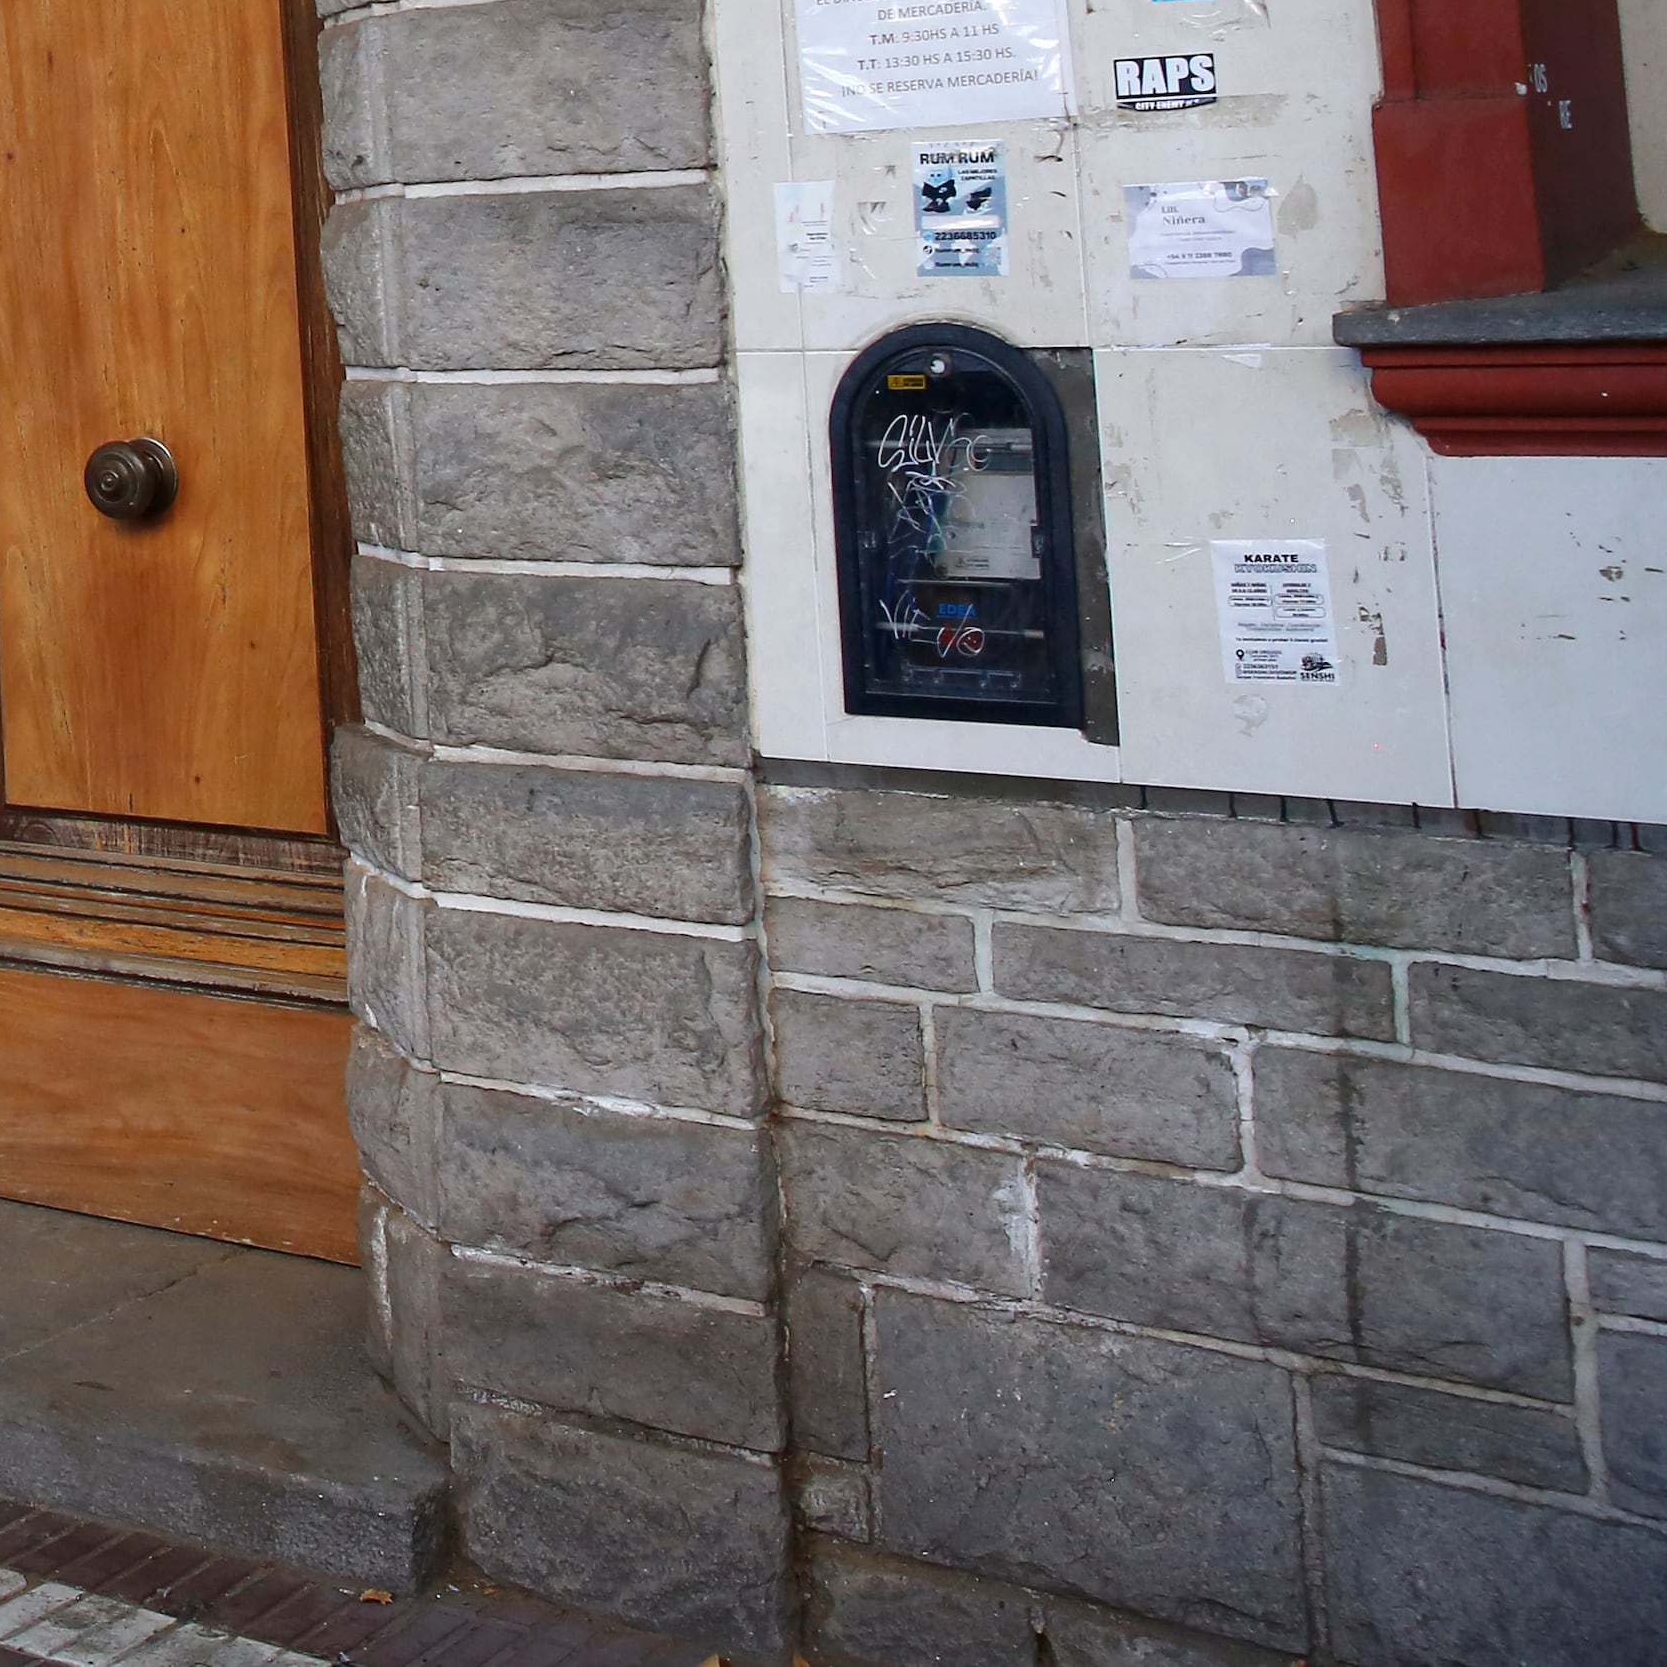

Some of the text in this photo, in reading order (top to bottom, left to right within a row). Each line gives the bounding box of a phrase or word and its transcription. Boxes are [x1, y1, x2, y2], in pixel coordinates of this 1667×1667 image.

[877, 0, 987, 21] DE MERCADERÍA.
[869, 24, 1000, 46] T.M: 9:30HS A 11 HS
[857, 46, 1017, 71] T.T: 13:30 HS A 15:30 HS.
[870, 81, 884, 94] SE
[887, 77, 944, 92] RESERVA
[947, 69, 1039, 89] MERCADERÍA!
[1115, 55, 1215, 96] RAPS
[1135, 102, 1155, 110] CITY
[919, 151, 995, 164] RUM RUM
[1163, 215, 1206, 225] Niñera
[1244, 554, 1299, 563] KARATE
